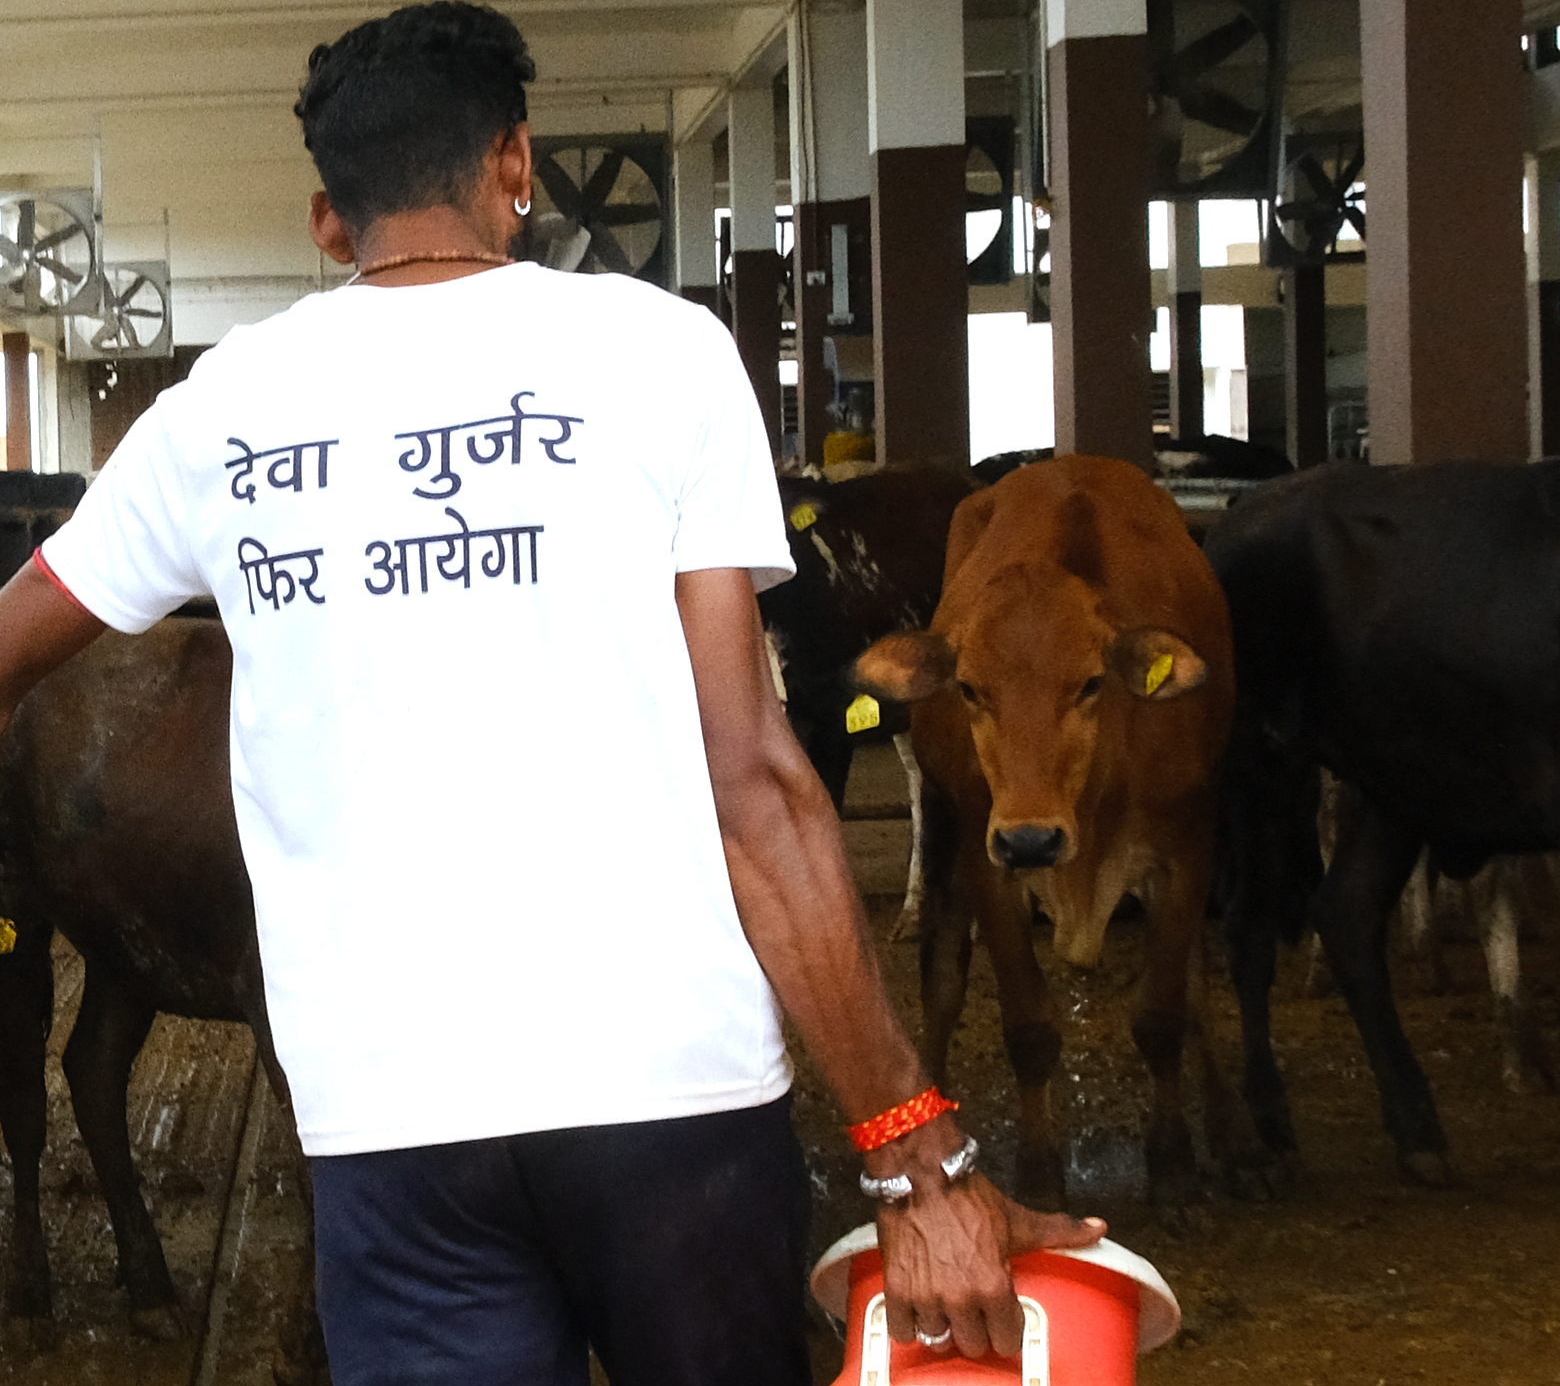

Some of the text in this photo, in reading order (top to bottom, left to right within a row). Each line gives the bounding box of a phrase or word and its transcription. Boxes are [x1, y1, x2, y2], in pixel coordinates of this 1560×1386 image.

[224, 391, 585, 505] देवा गुर्जर
[237, 506, 545, 615] फिर आयेगा
